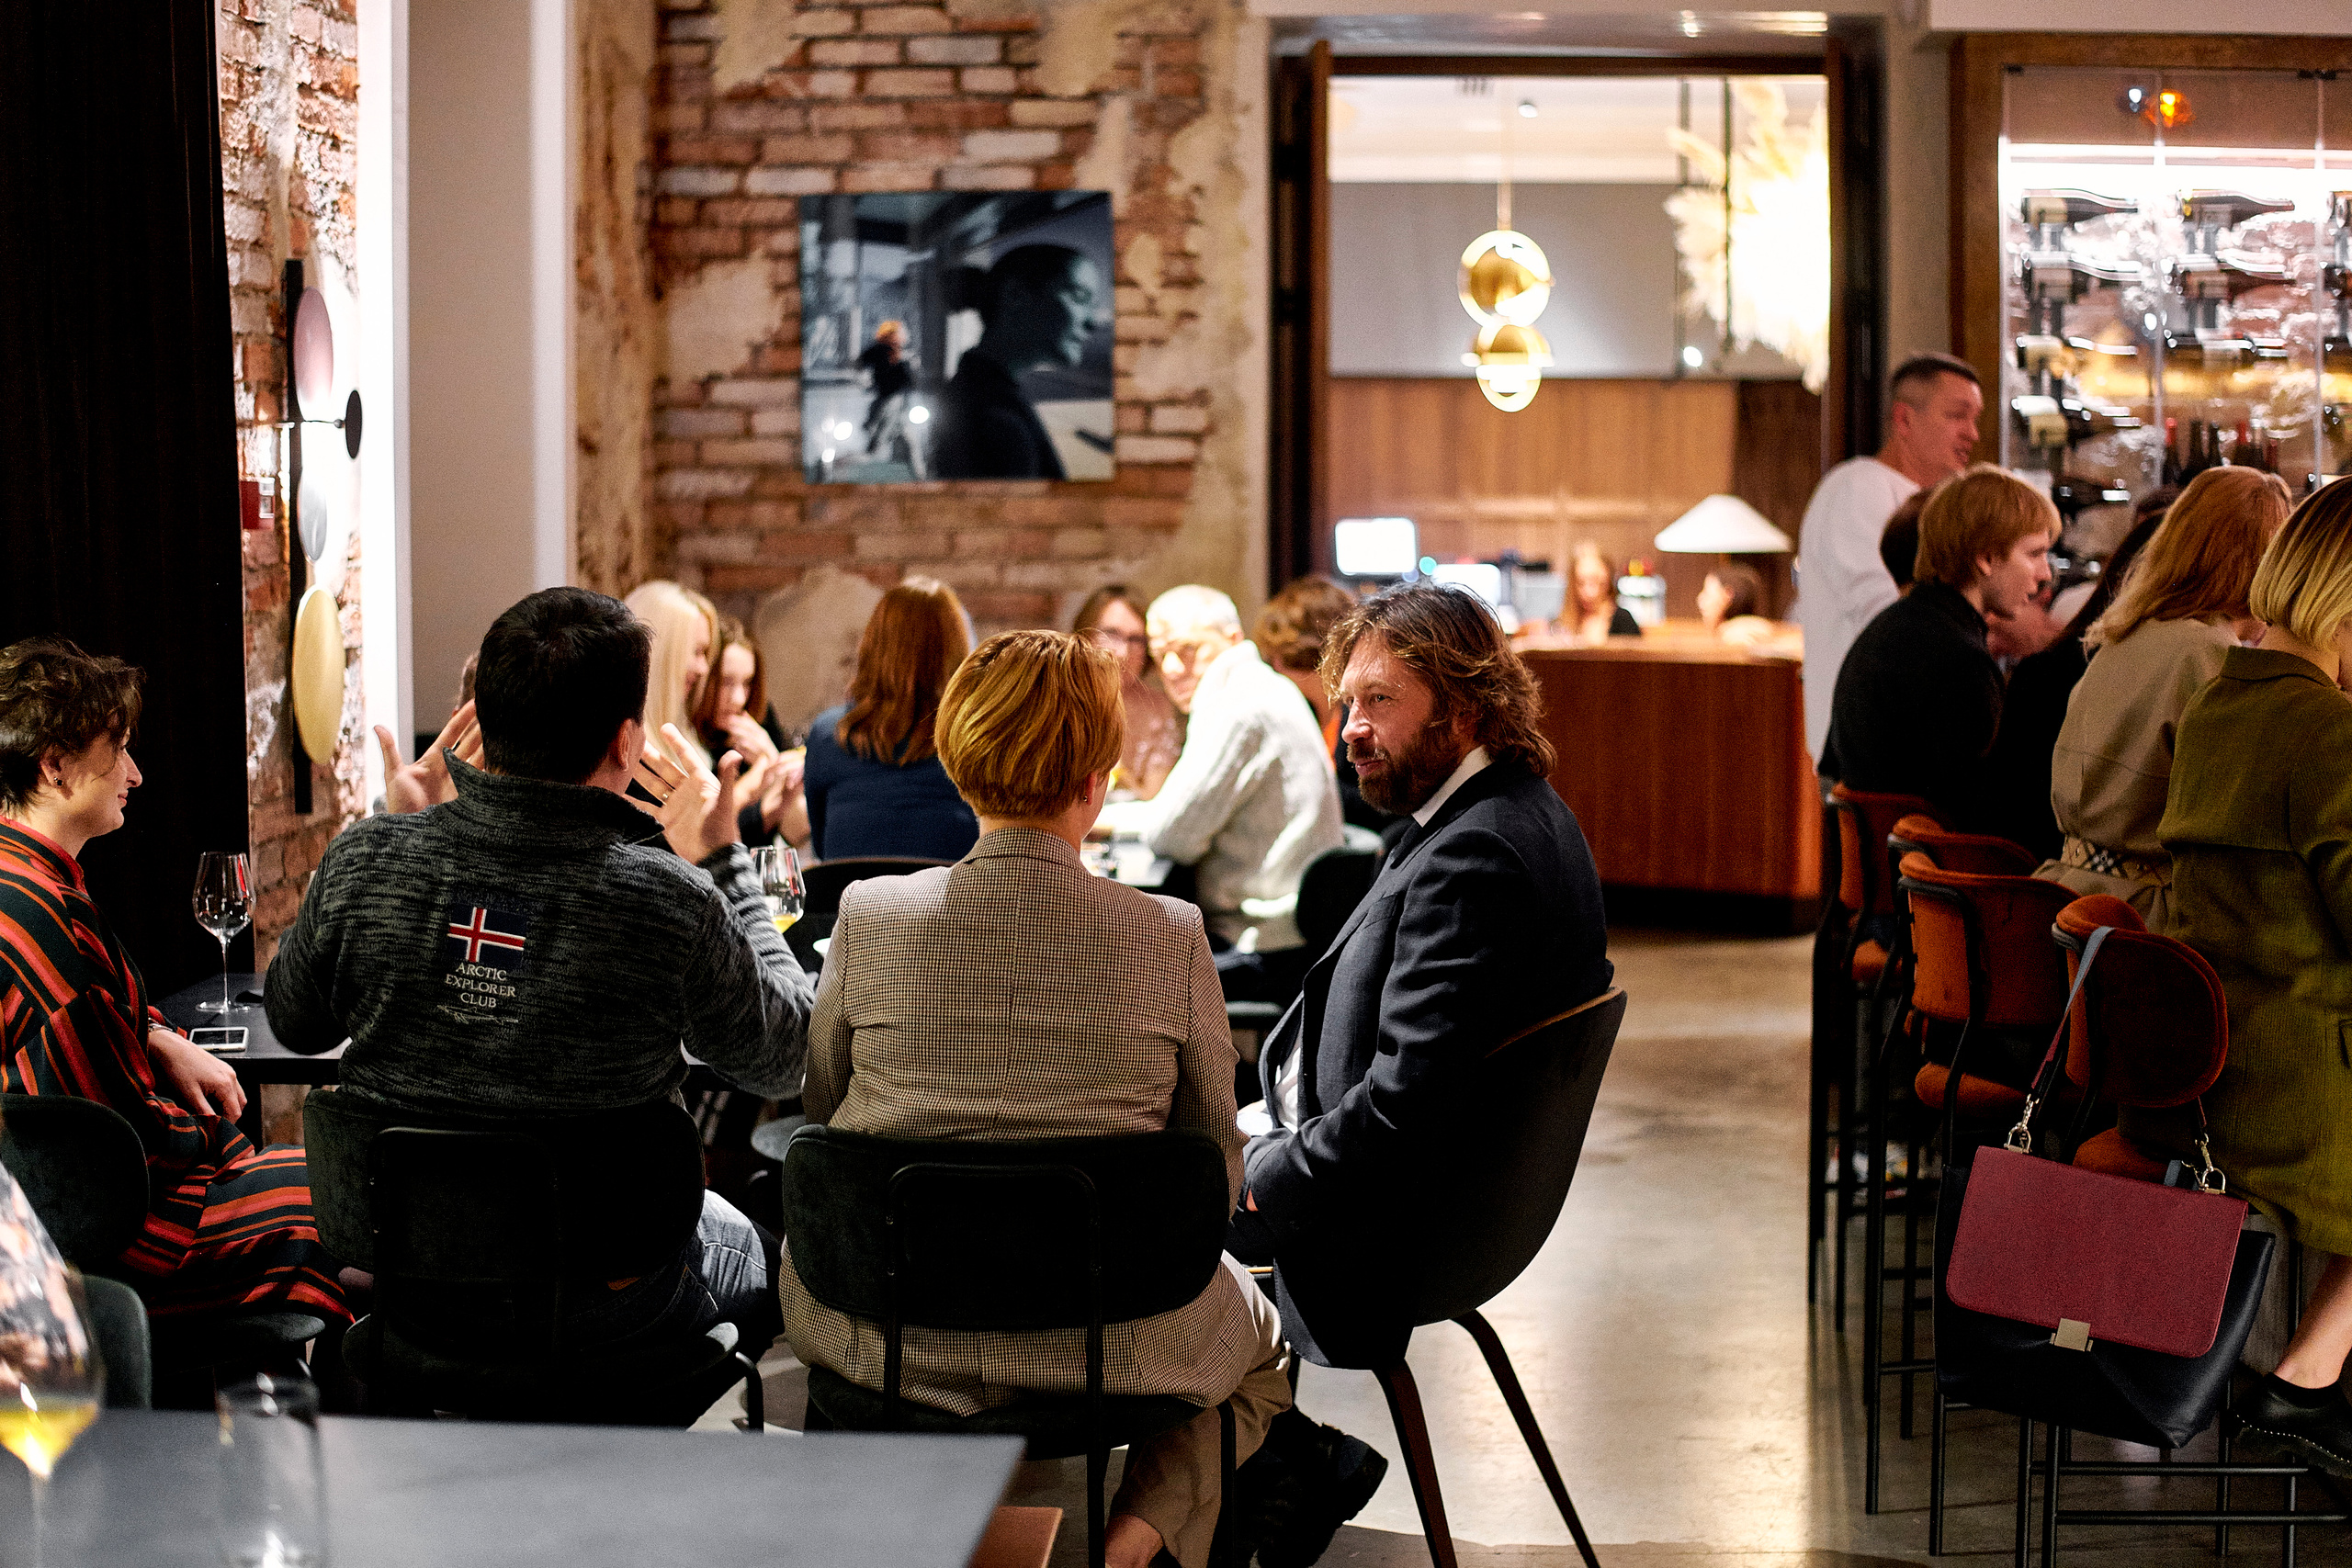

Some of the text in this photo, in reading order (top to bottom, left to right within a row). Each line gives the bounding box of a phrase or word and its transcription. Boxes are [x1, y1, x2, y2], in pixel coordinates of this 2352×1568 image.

[456, 963, 507, 981] ARCTIC
[445, 974, 516, 998] EXPLORER
[460, 992, 497, 1008] CLUB
